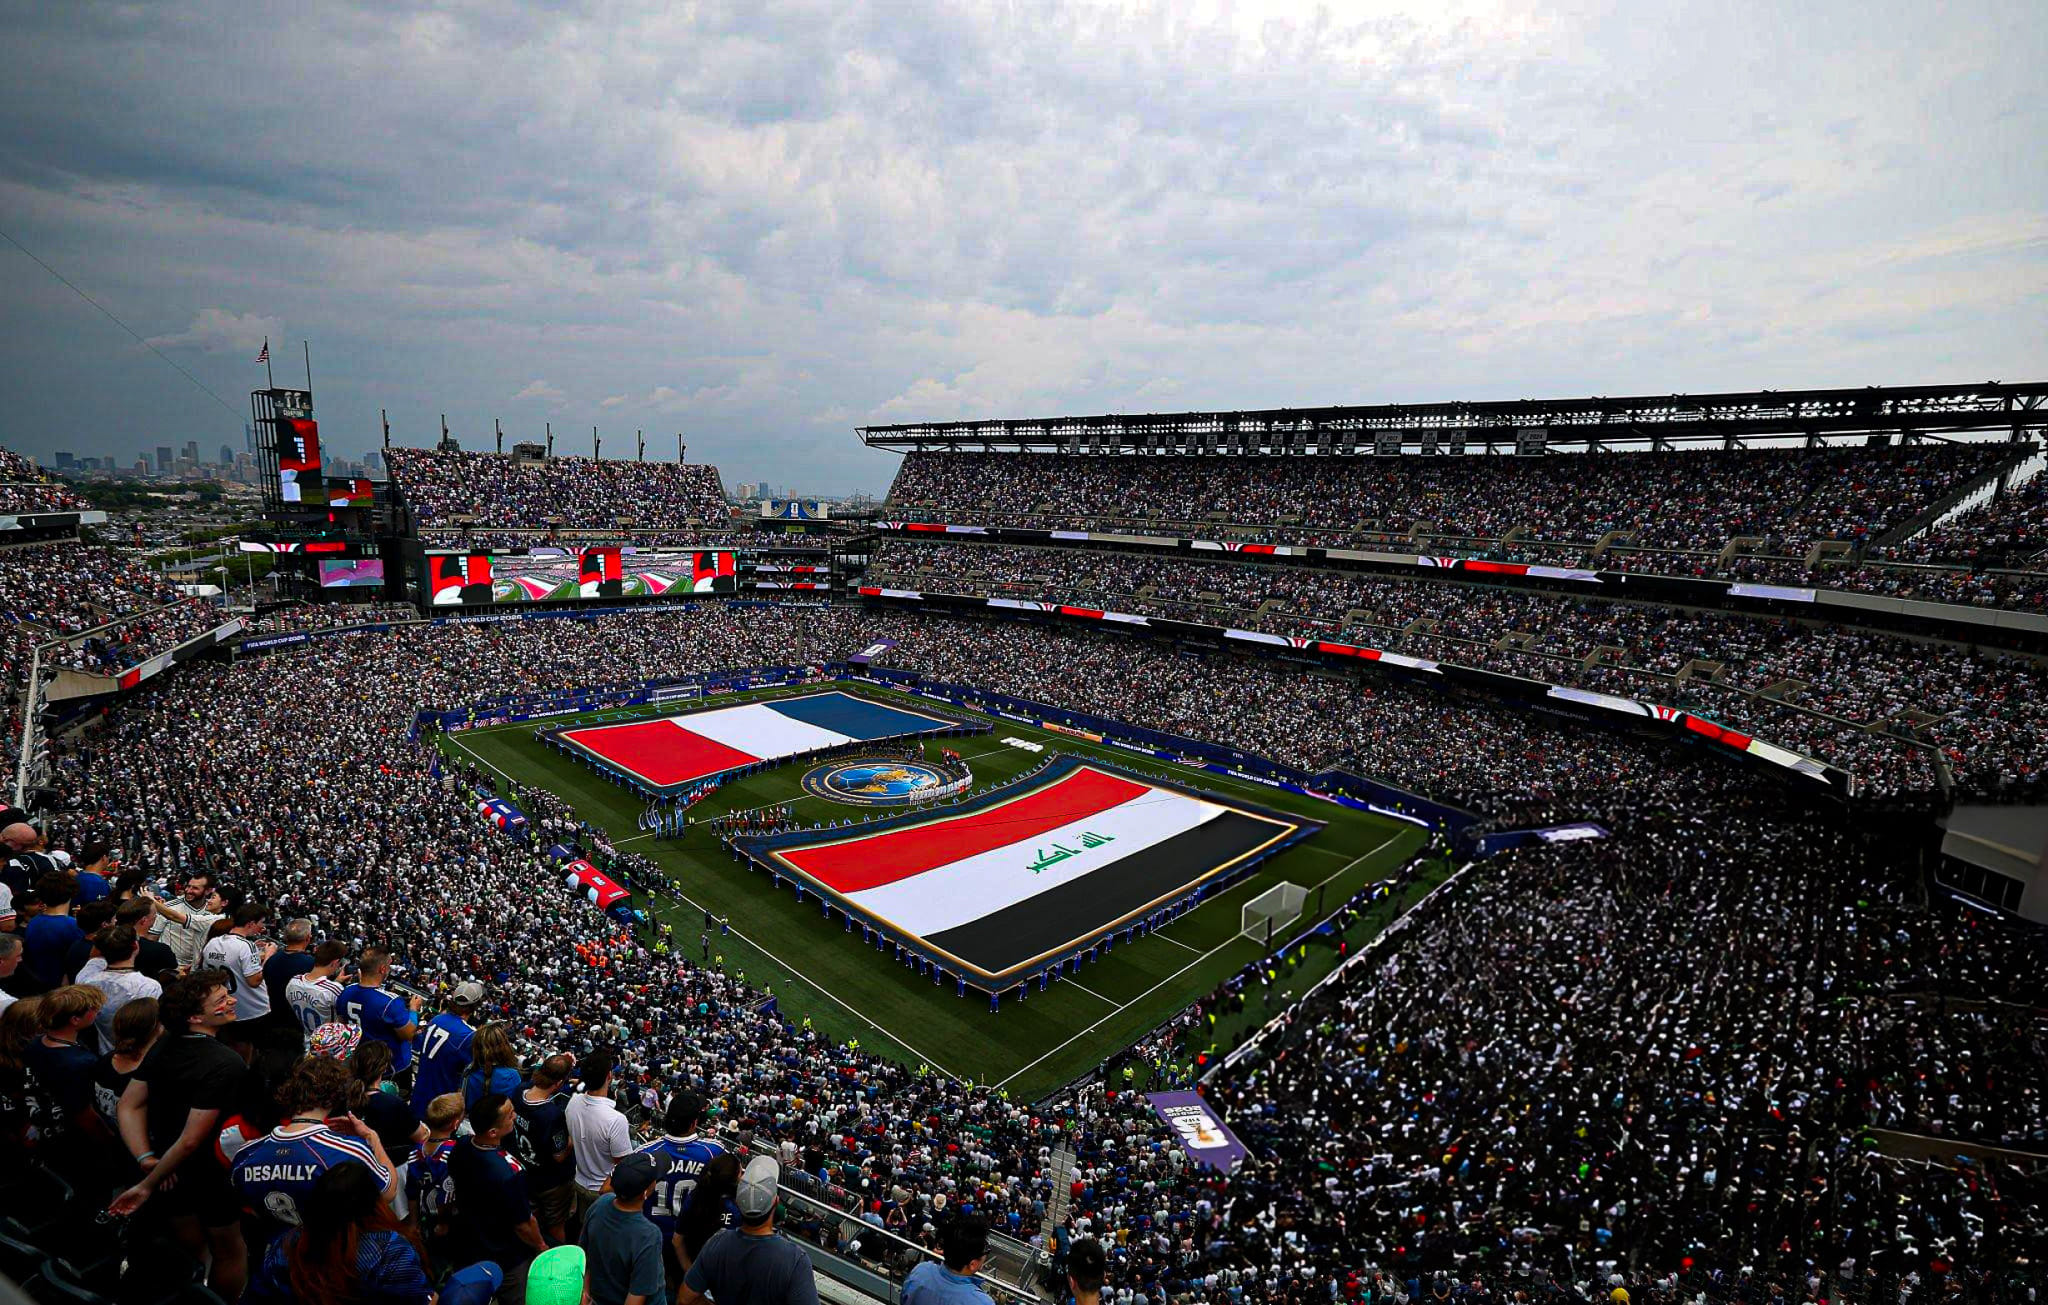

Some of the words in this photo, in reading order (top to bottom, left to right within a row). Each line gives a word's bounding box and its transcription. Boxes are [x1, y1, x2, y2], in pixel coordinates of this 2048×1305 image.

[1232, 751, 1244, 759] FIFA
[1237, 772, 1254, 780] WORLD
[422, 1023, 451, 1060] 17
[243, 1164, 318, 1182] DESAILLY
